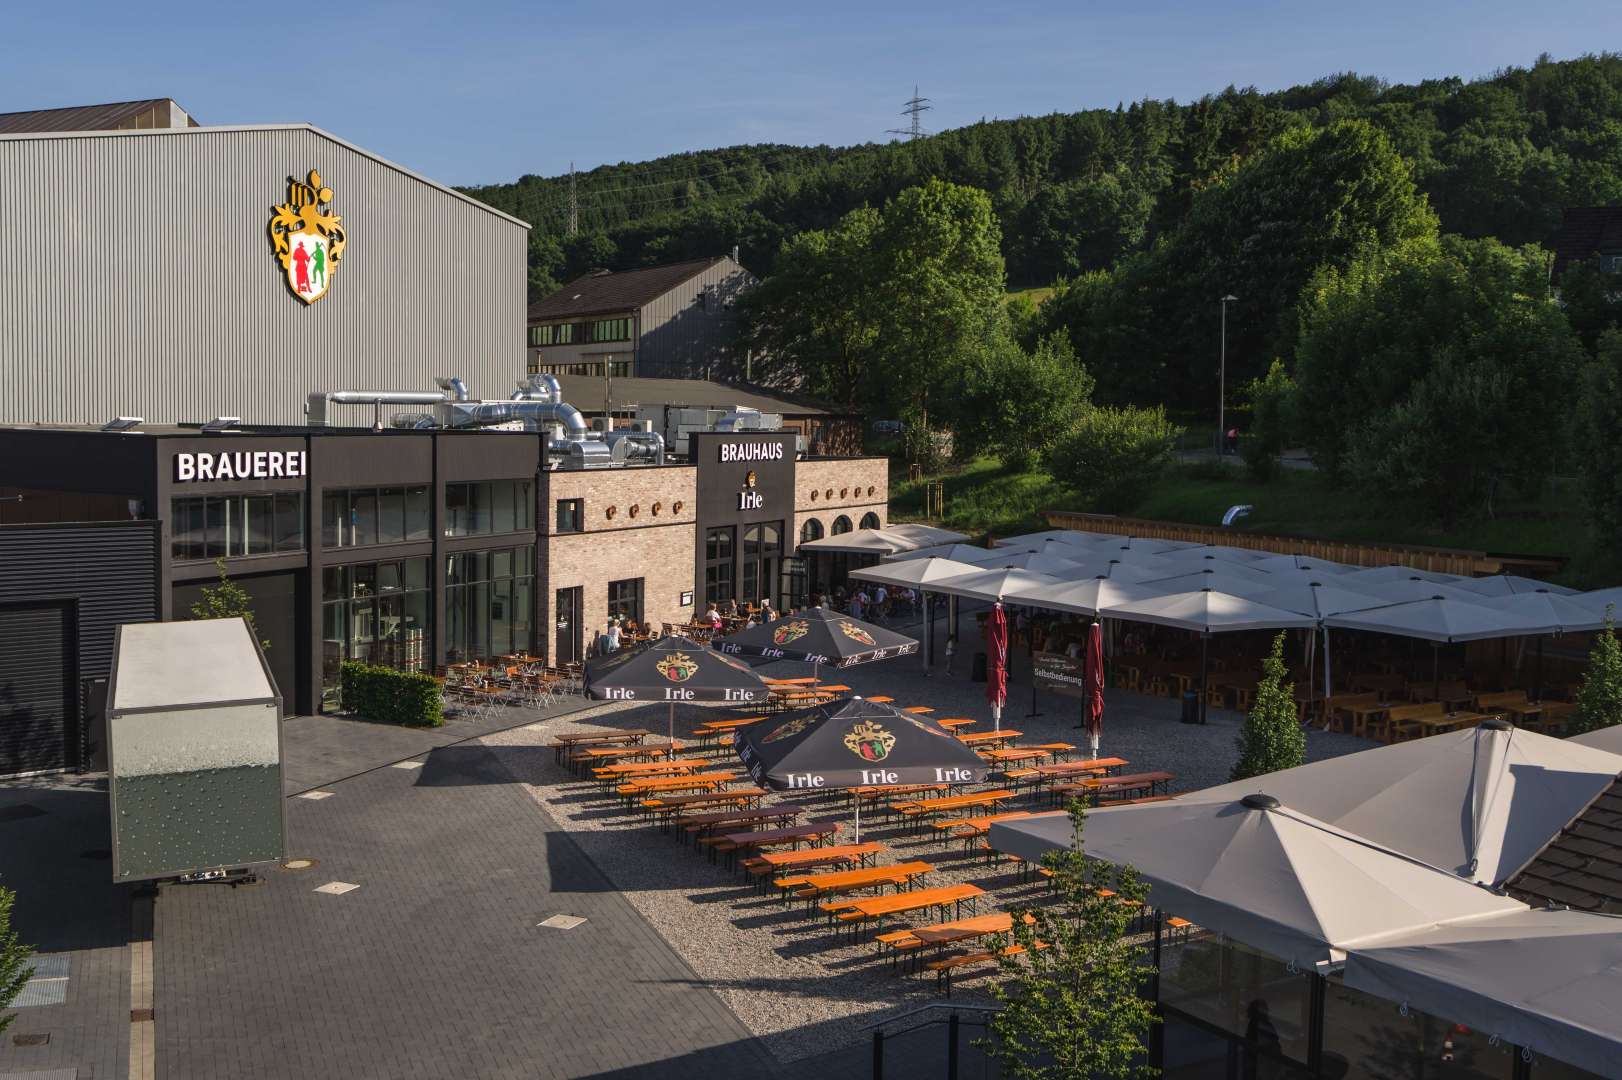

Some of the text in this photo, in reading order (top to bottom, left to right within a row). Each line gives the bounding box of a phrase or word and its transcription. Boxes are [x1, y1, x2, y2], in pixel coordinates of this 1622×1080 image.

[721, 442, 783, 461] BRAUHAUS
[178, 451, 306, 480] BRAUEREI
[740, 491, 763, 510] Irle
[721, 642, 828, 663] Irle Irle Irle
[1034, 668, 1082, 686] Selbstbedienung
[604, 687, 755, 701] Irle Irle Irle
[786, 767, 972, 789] Irle Irle Irle
